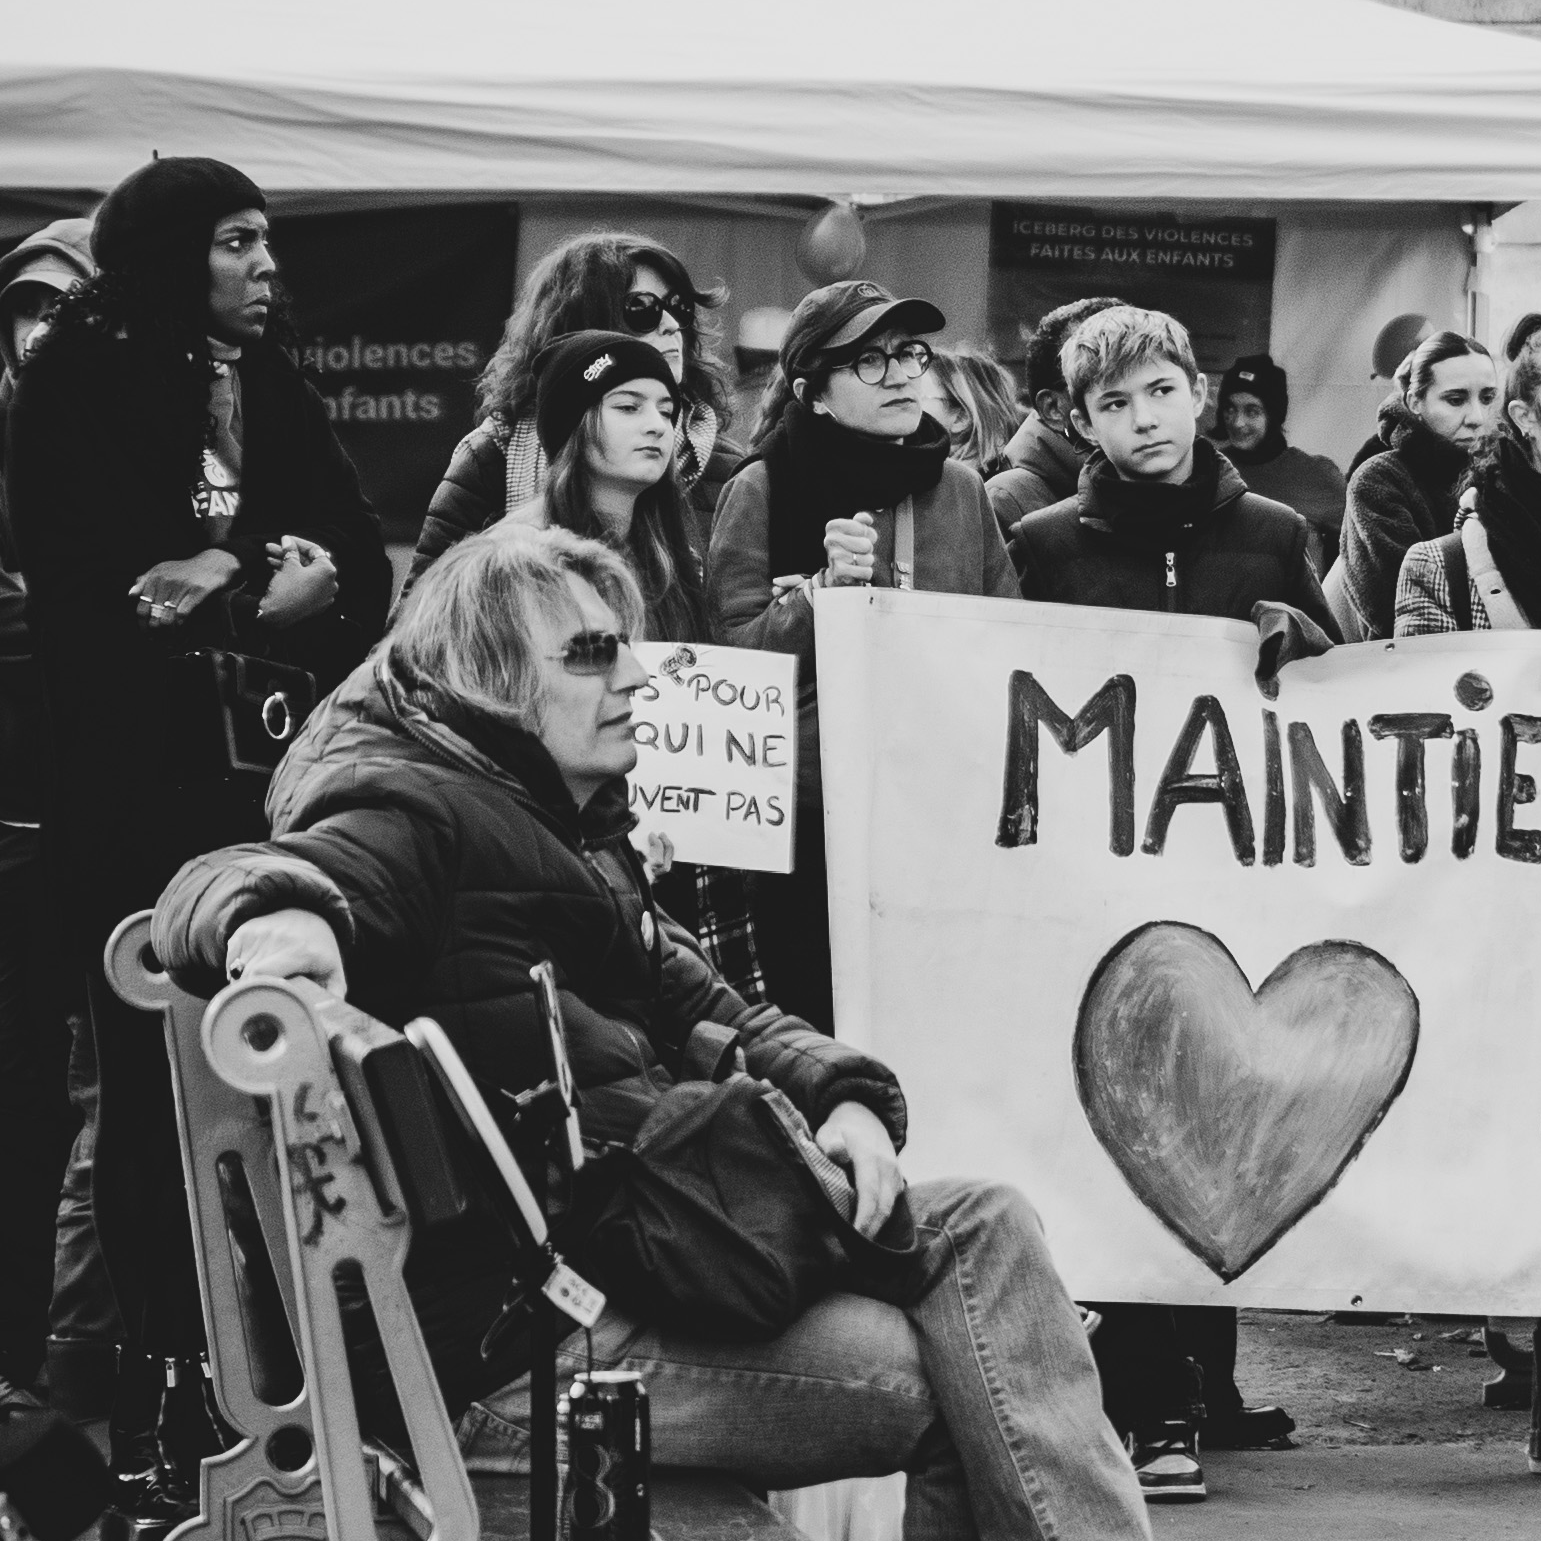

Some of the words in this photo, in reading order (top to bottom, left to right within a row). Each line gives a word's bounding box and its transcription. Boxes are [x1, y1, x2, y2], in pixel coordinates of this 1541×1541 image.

[1100, 225, 1139, 240] DES
[1144, 228, 1253, 247] VIOLENCES
[1030, 243, 1096, 260] FAITES
[1100, 247, 1140, 264] AUX
[1146, 249, 1235, 268] ENFANTS
[686, 673, 785, 718] POUR
[633, 720, 704, 757] QUI
[724, 728, 787, 768] NE
[725, 790, 786, 827] PAS
